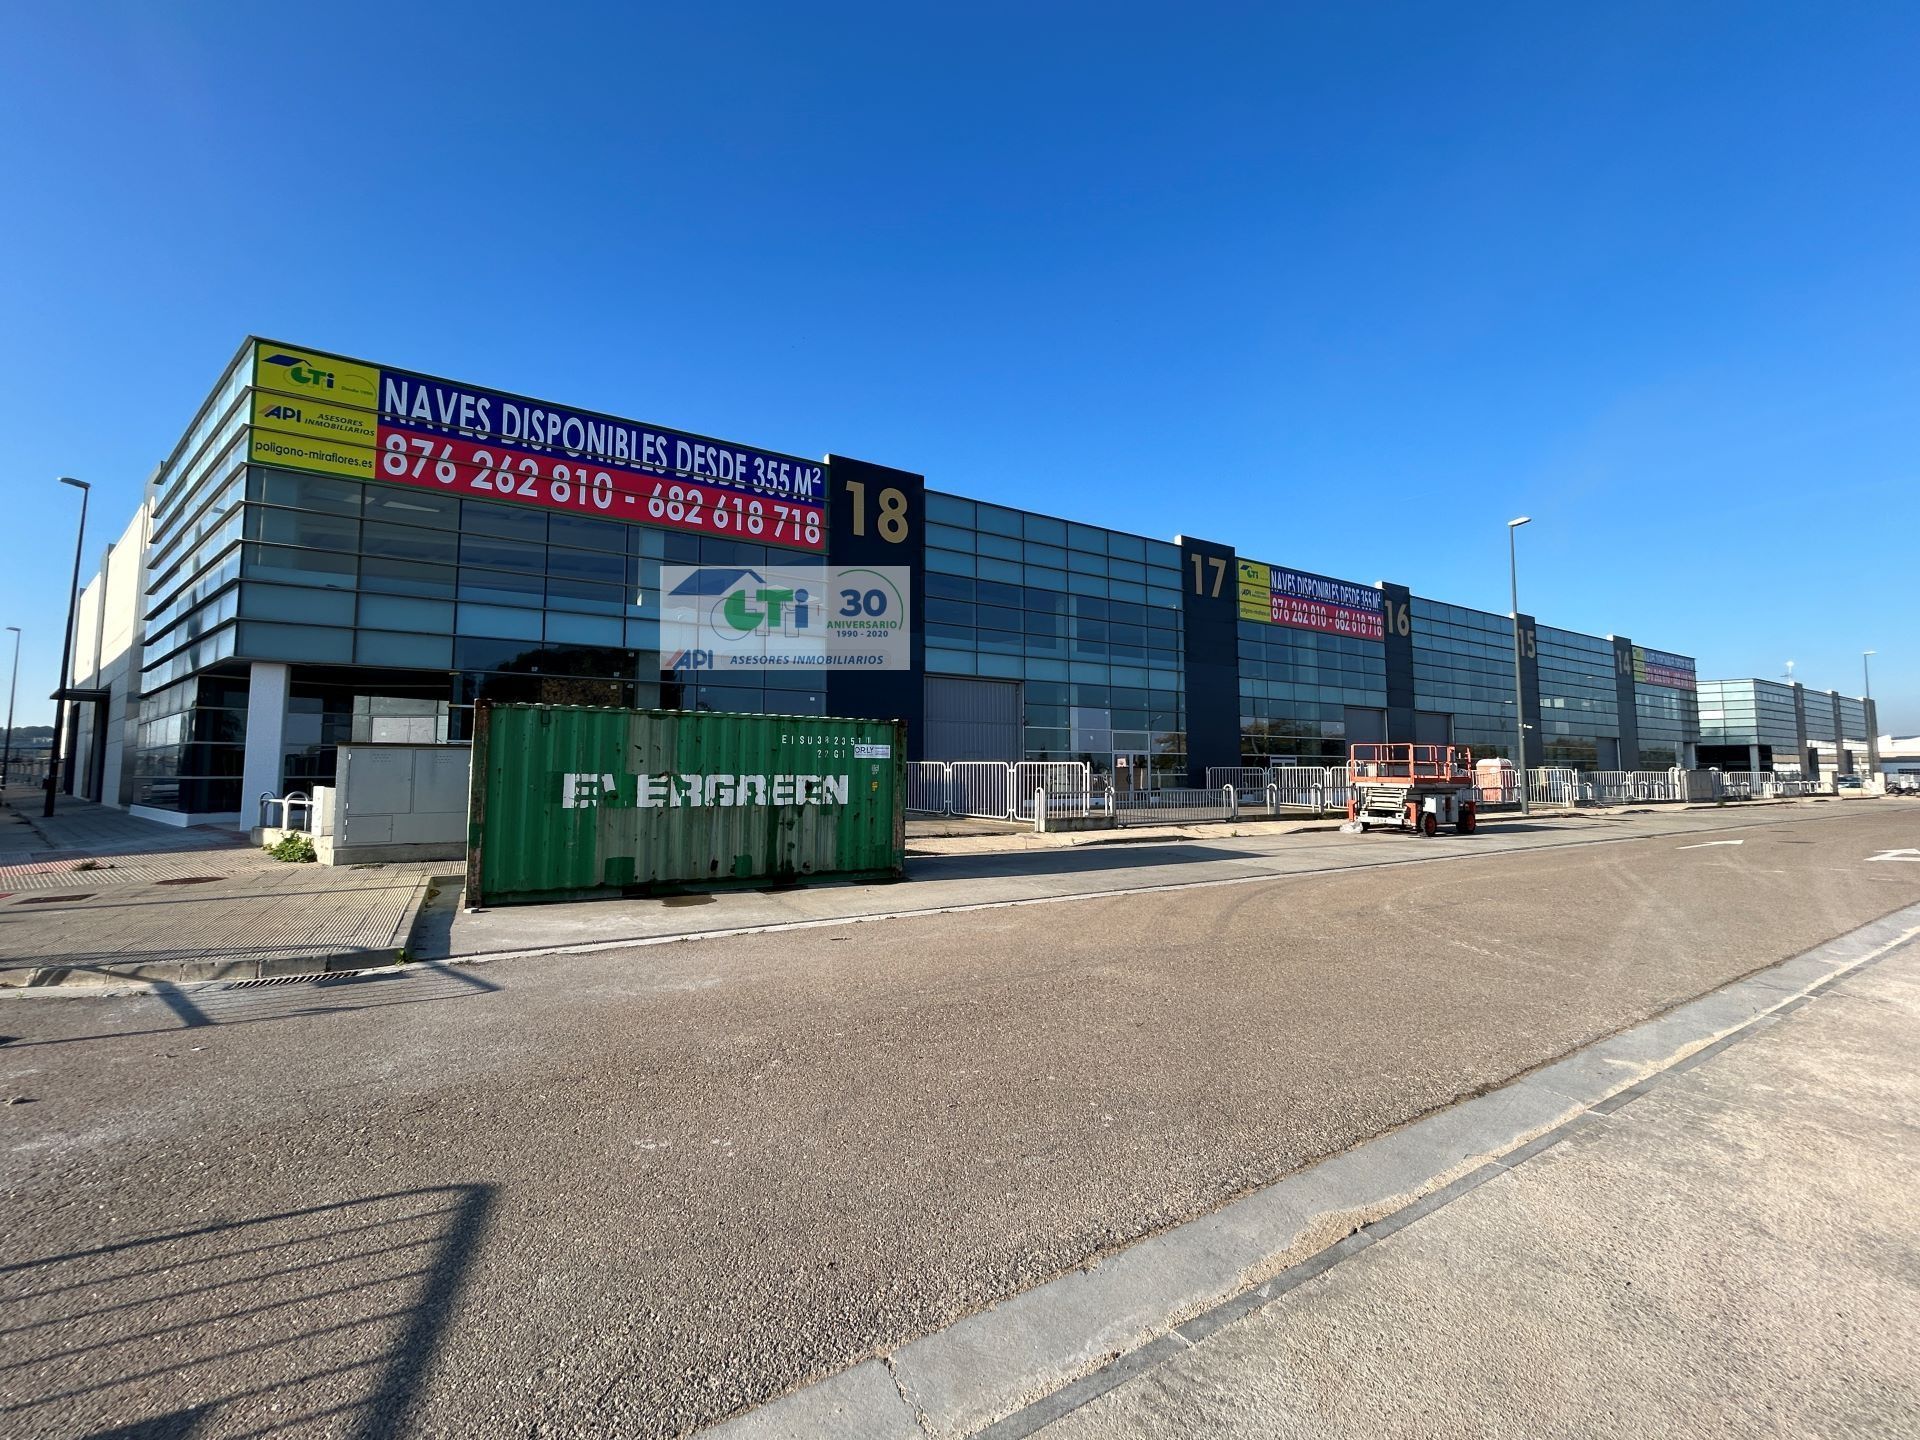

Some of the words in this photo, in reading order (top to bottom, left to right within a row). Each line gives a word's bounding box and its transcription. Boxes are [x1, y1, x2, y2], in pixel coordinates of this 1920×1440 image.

[263, 405, 302, 423] API
[304, 418, 375, 437] INMOBILIARIOS
[317, 413, 364, 427] ASESORES
[255, 441, 373, 469] poligono-miraflores.es
[384, 378, 492, 440] NAVES
[501, 403, 668, 474] DISPONIBLES
[676, 440, 747, 487] DESDE
[752, 457, 790, 497] 355
[383, 434, 457, 484] 876
[470, 449, 539, 498] 262
[550, 464, 613, 510] 810
[648, 482, 703, 525] 682
[712, 494, 764, 535] 618
[774, 504, 821, 545] 718
[845, 480, 909, 544] 18
[1190, 552, 1227, 599] 17
[1270, 570, 1296, 597] NAVES
[1297, 576, 1339, 605] DISPONIBLES
[1340, 585, 1361, 609] DESDE
[1361, 589, 1372, 611] 355
[1272, 597, 1290, 622] 876
[1291, 601, 1309, 624] 262
[1310, 604, 1327, 628] 810
[1335, 609, 1350, 631] 682
[1351, 612, 1367, 634] 618
[1367, 615, 1382, 637] 718
[1384, 599, 1410, 637] 16
[1518, 628, 1536, 660] 15
[1616, 650, 1631, 676] 14
